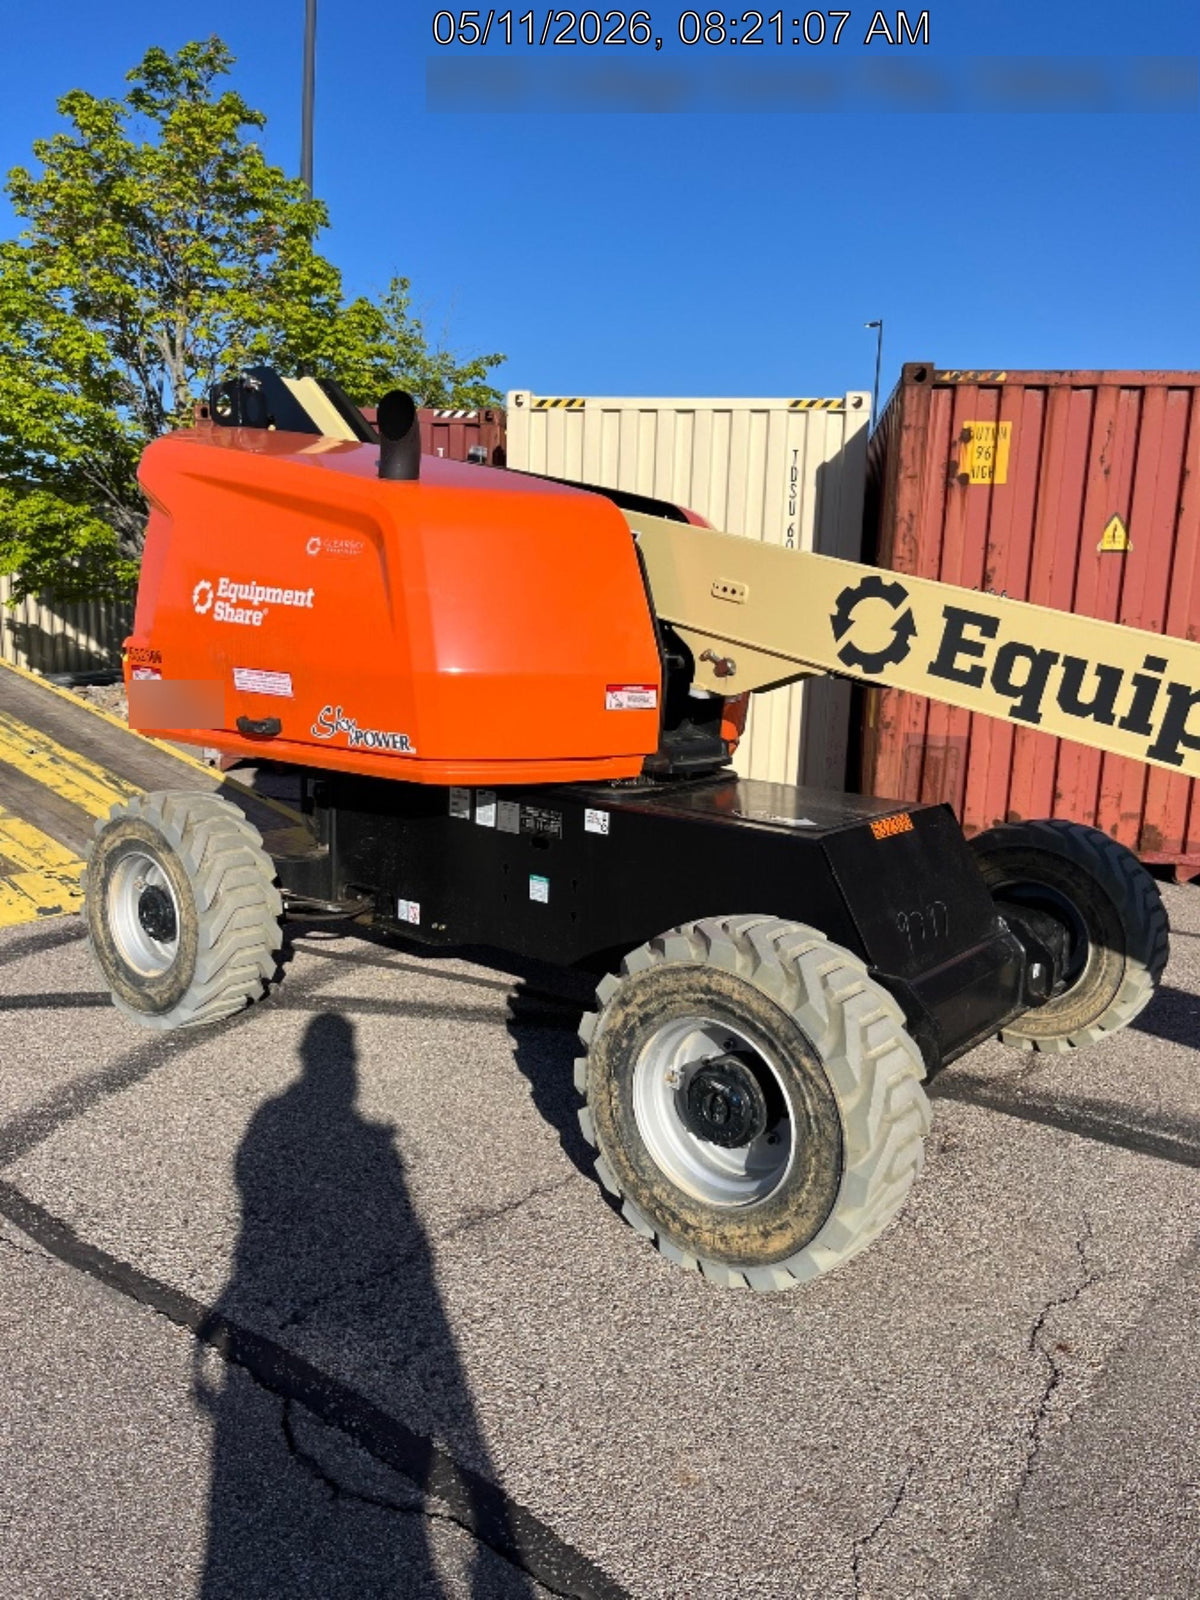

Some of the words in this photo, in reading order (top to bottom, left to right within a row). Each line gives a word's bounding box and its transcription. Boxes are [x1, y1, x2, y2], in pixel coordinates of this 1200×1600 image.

[789, 449, 799, 516] TDSU
[216, 577, 315, 608] Equipment
[927, 604, 1200, 766] Equip
[353, 729, 411, 751] POWER
